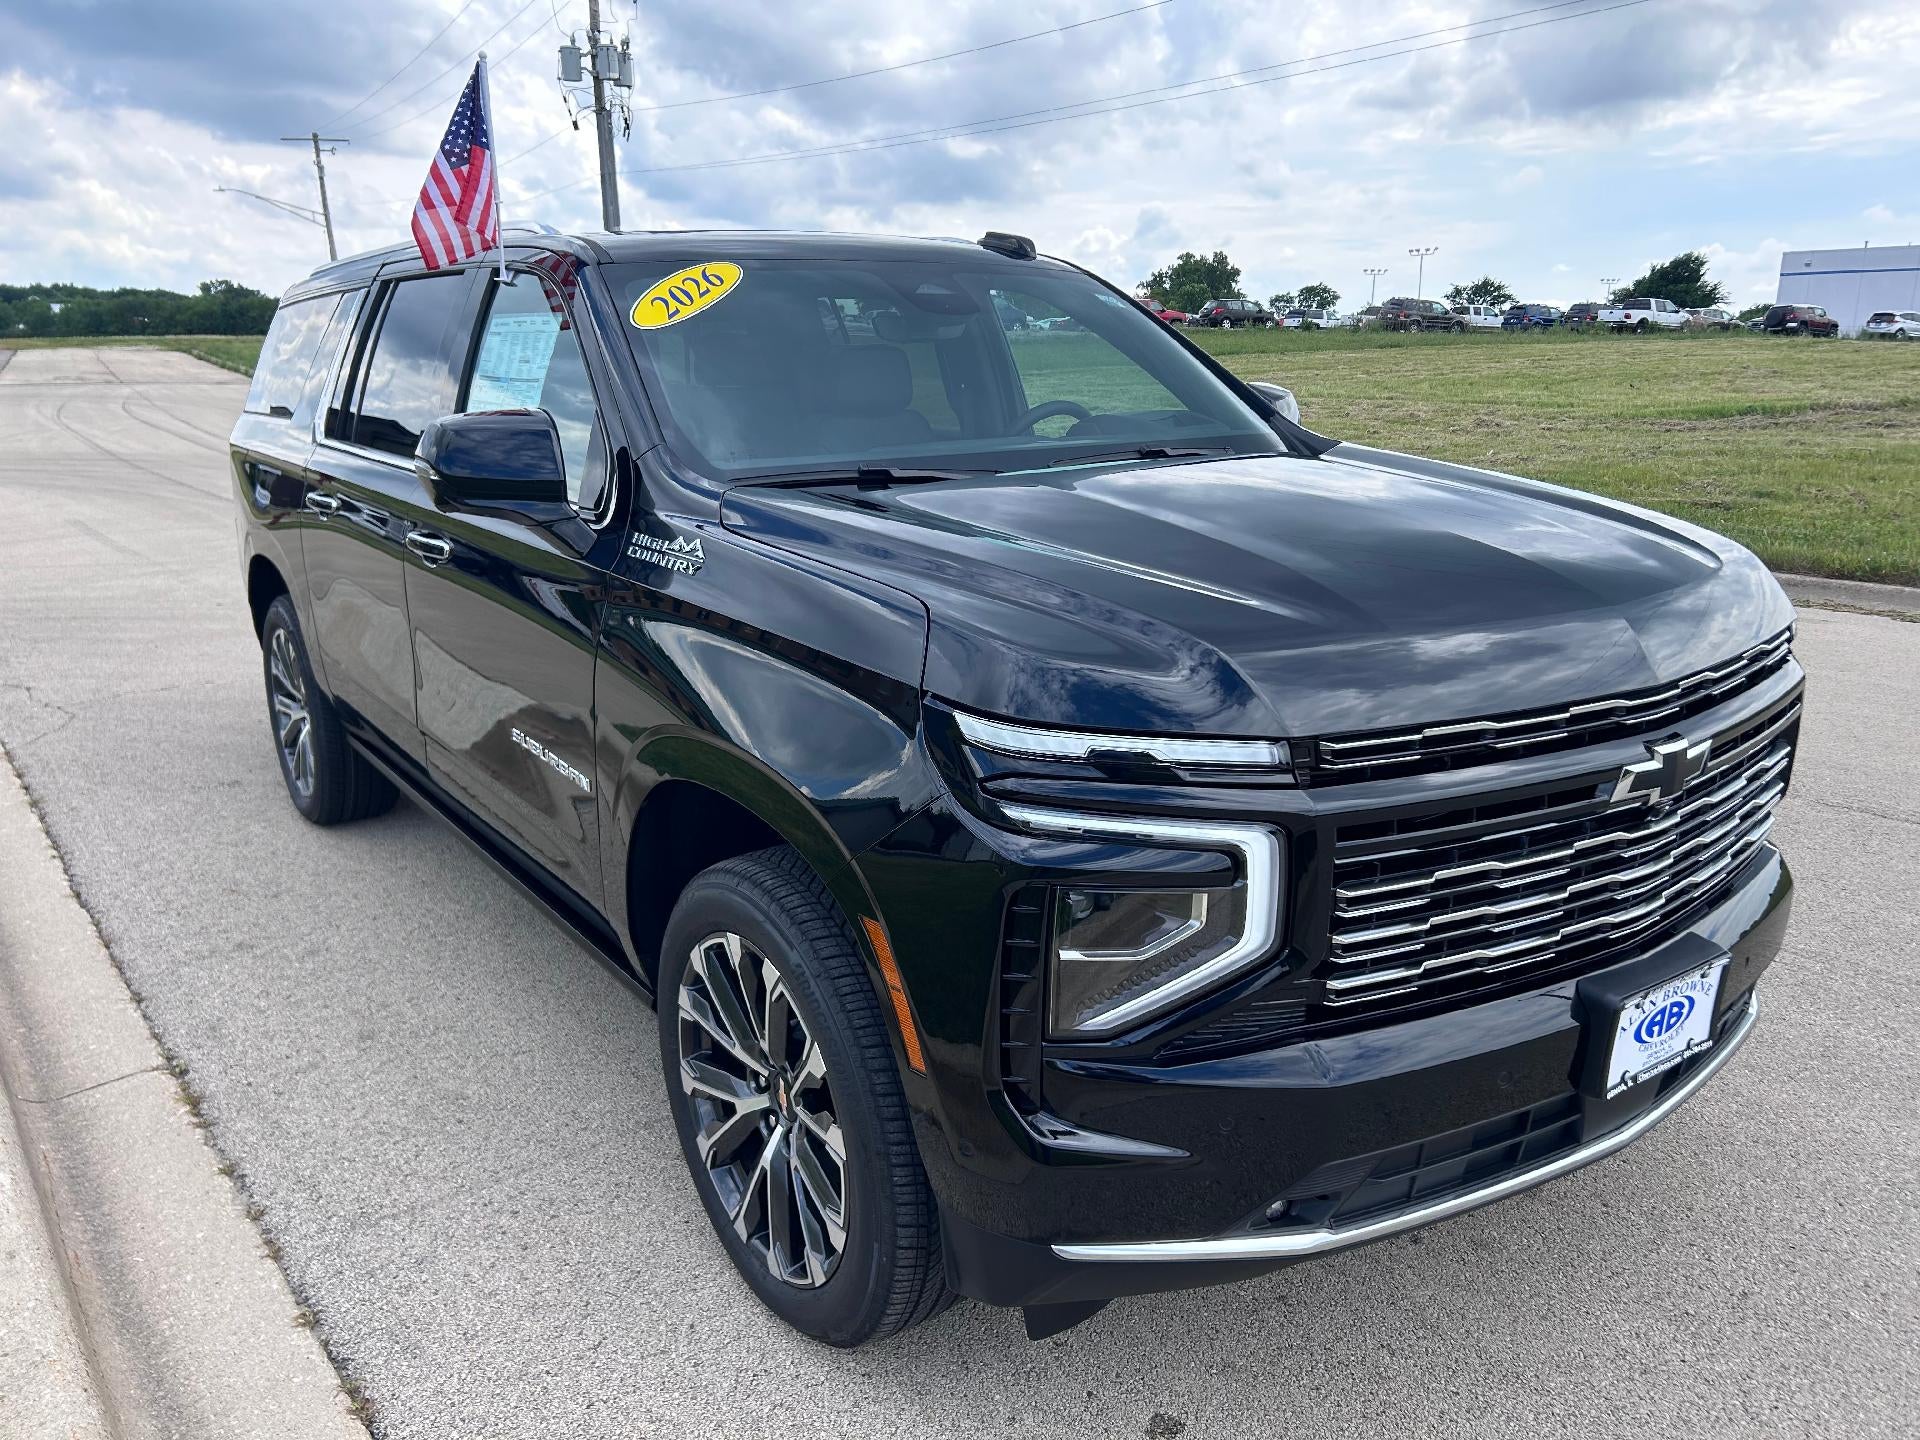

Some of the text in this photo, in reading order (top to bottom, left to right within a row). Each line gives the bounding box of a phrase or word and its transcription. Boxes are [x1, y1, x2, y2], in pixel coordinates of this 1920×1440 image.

[651, 266, 724, 320] 2026
[627, 546, 702, 576] COUNTRY
[632, 532, 670, 552] HIGH
[512, 727, 592, 793] SUBURBAN
[1618, 996, 1658, 1040] ALAN
[1662, 979, 1714, 1002] BROWNE
[1644, 1000, 1686, 1039] AB
[1638, 1024, 1686, 1052] CHEVROLET
